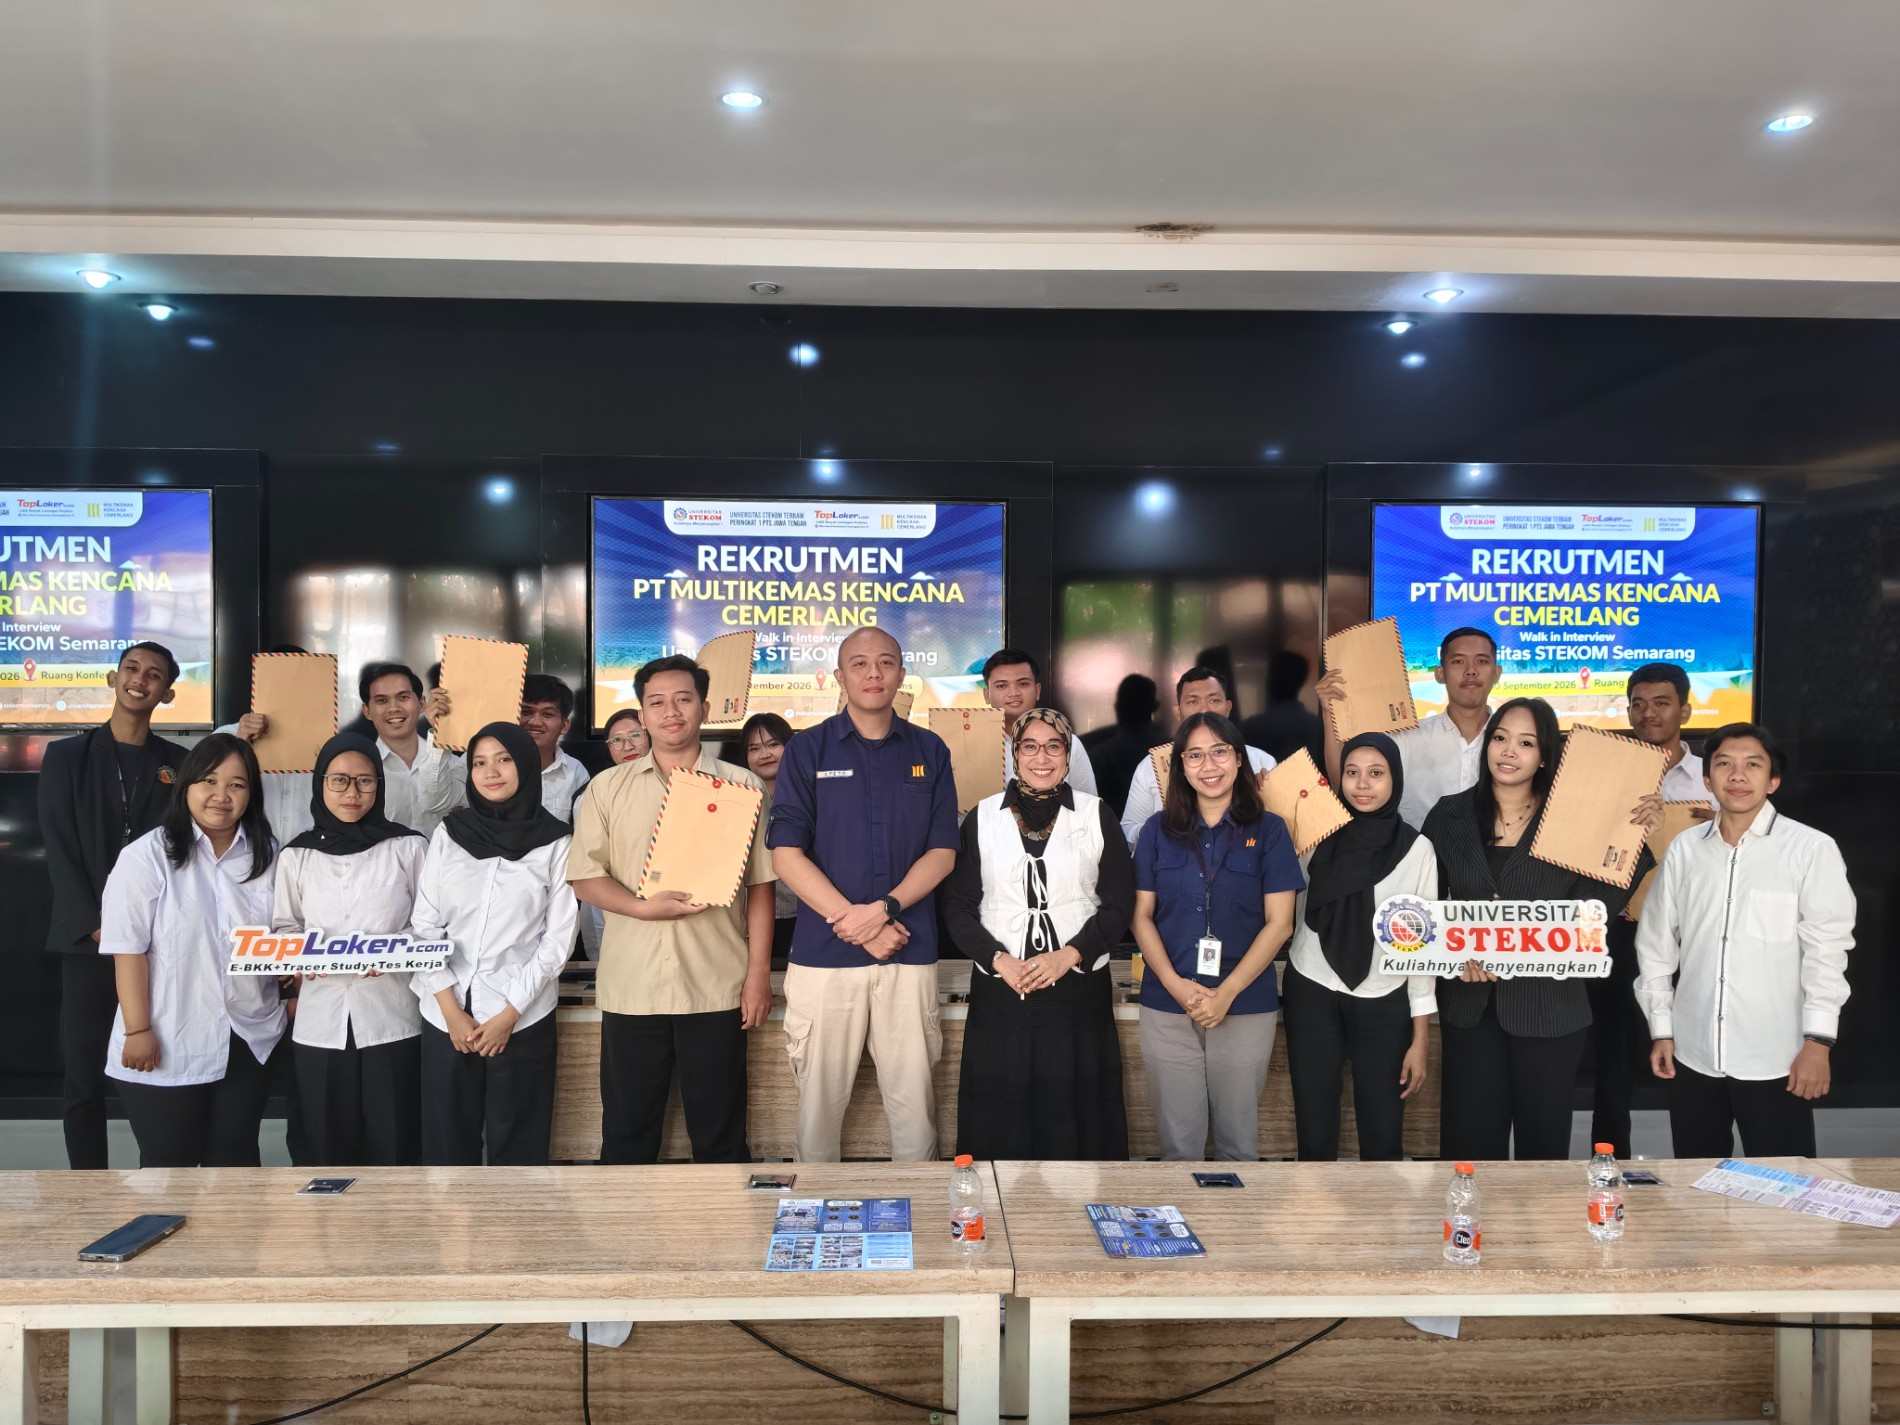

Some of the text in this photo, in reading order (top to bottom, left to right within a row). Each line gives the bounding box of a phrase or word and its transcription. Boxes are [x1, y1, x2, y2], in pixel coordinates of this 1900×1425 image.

[698, 545, 903, 574] REKRUTMEN
[1472, 549, 1664, 575] REKRUTMEN
[48, 571, 171, 592] KENCANA
[634, 578, 964, 603] PT MULTIKEMAS KENCANA
[1410, 582, 1721, 603] PT MULTIKEMAS KENCANA
[722, 604, 878, 627] CEMERLANG
[1494, 606, 1640, 627] CEMERLANG
[2, 622, 62, 632] Interview
[60, 636, 148, 651] Semaran
[783, 632, 793, 643] in
[797, 632, 846, 643] Intervie
[1520, 632, 1615, 642] Walk in Interview
[1534, 646, 1608, 660] STEKOM
[1612, 646, 1695, 662] Semarang
[41, 671, 74, 681] Ruang
[1503, 680, 1553, 691] September
[1554, 680, 1577, 690] 2026
[1594, 678, 1625, 689] Ruang
[787, 682, 812, 690] 2026
[1443, 905, 1602, 922] UNIVERSITAS
[234, 929, 449, 960] TopLoker.com
[1446, 927, 1604, 953] STEKOM
[230, 960, 443, 973] E-BKK+Tracer Study+Tes Kerja
[1384, 959, 1466, 976] Kuliahnya
